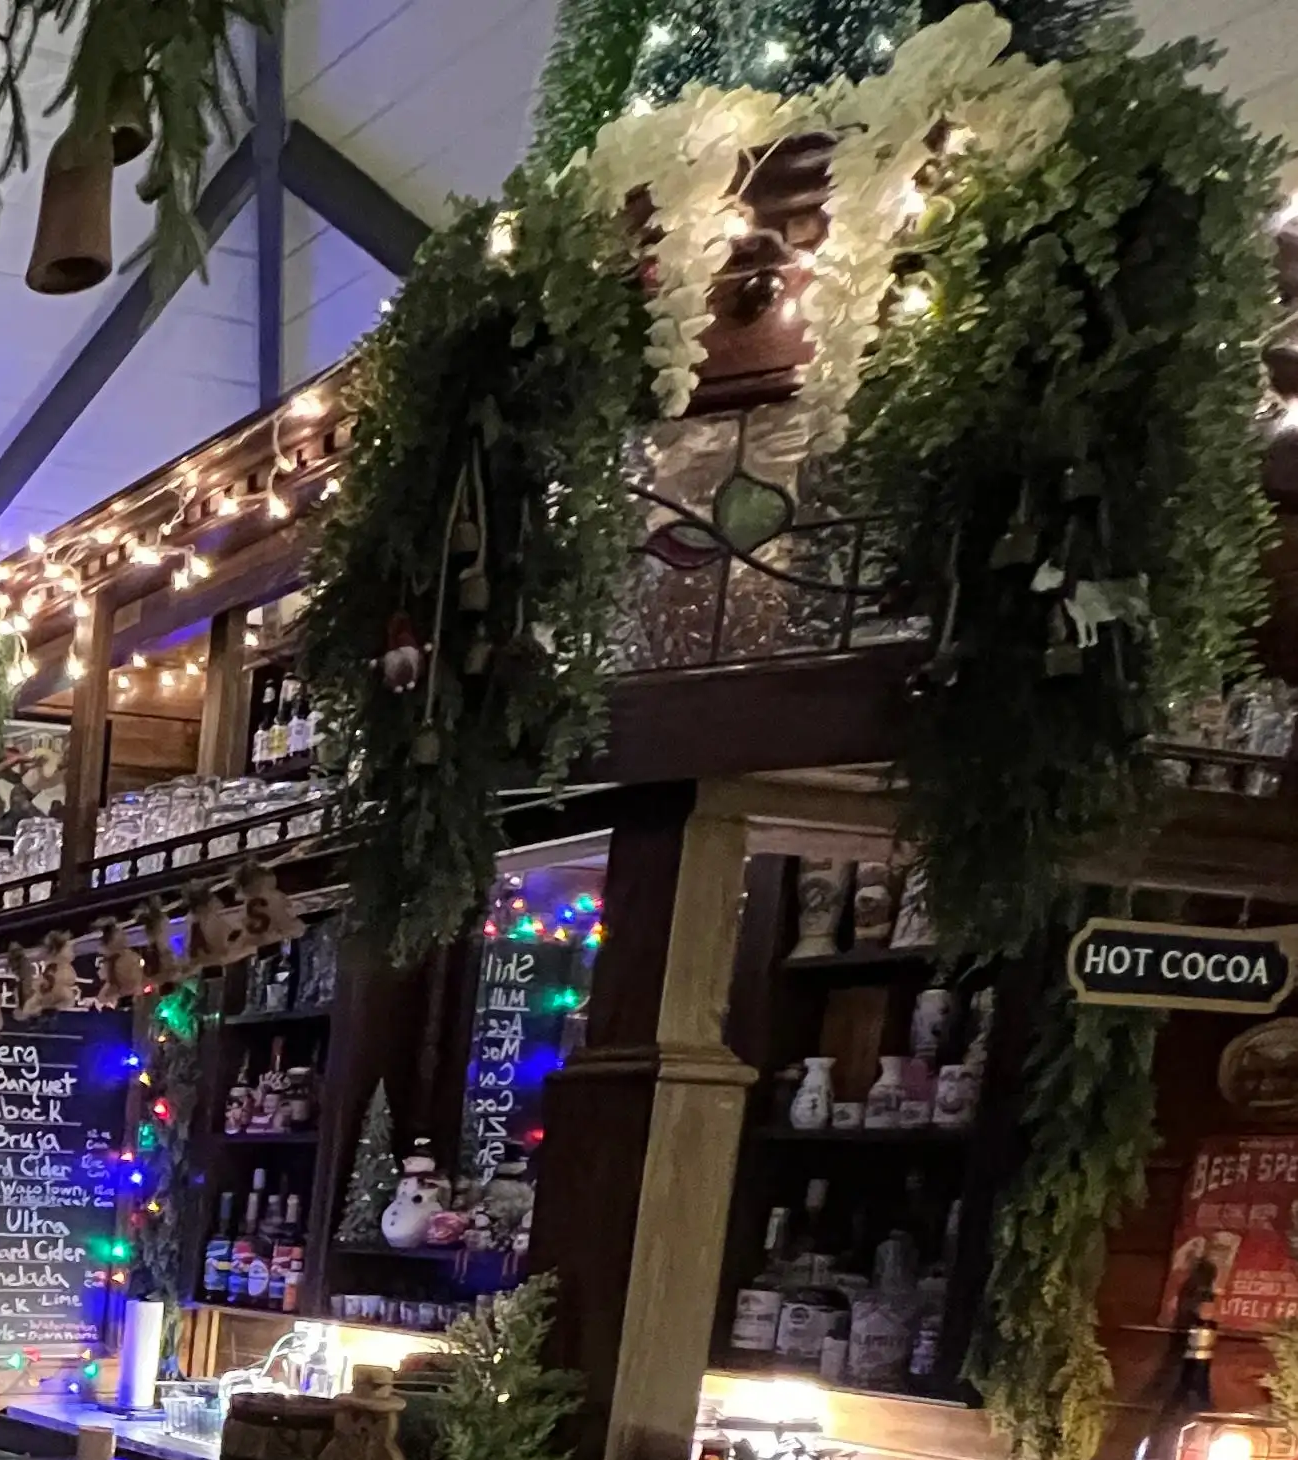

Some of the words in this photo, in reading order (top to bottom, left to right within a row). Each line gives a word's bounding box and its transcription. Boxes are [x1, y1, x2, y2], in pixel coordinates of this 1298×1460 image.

[1084, 943, 1153, 977] HOT
[1160, 950, 1269, 985] COCOA
[20, 1155, 72, 1178] Cider
[6, 1208, 70, 1235] Ultra
[35, 1238, 86, 1263] Cider
